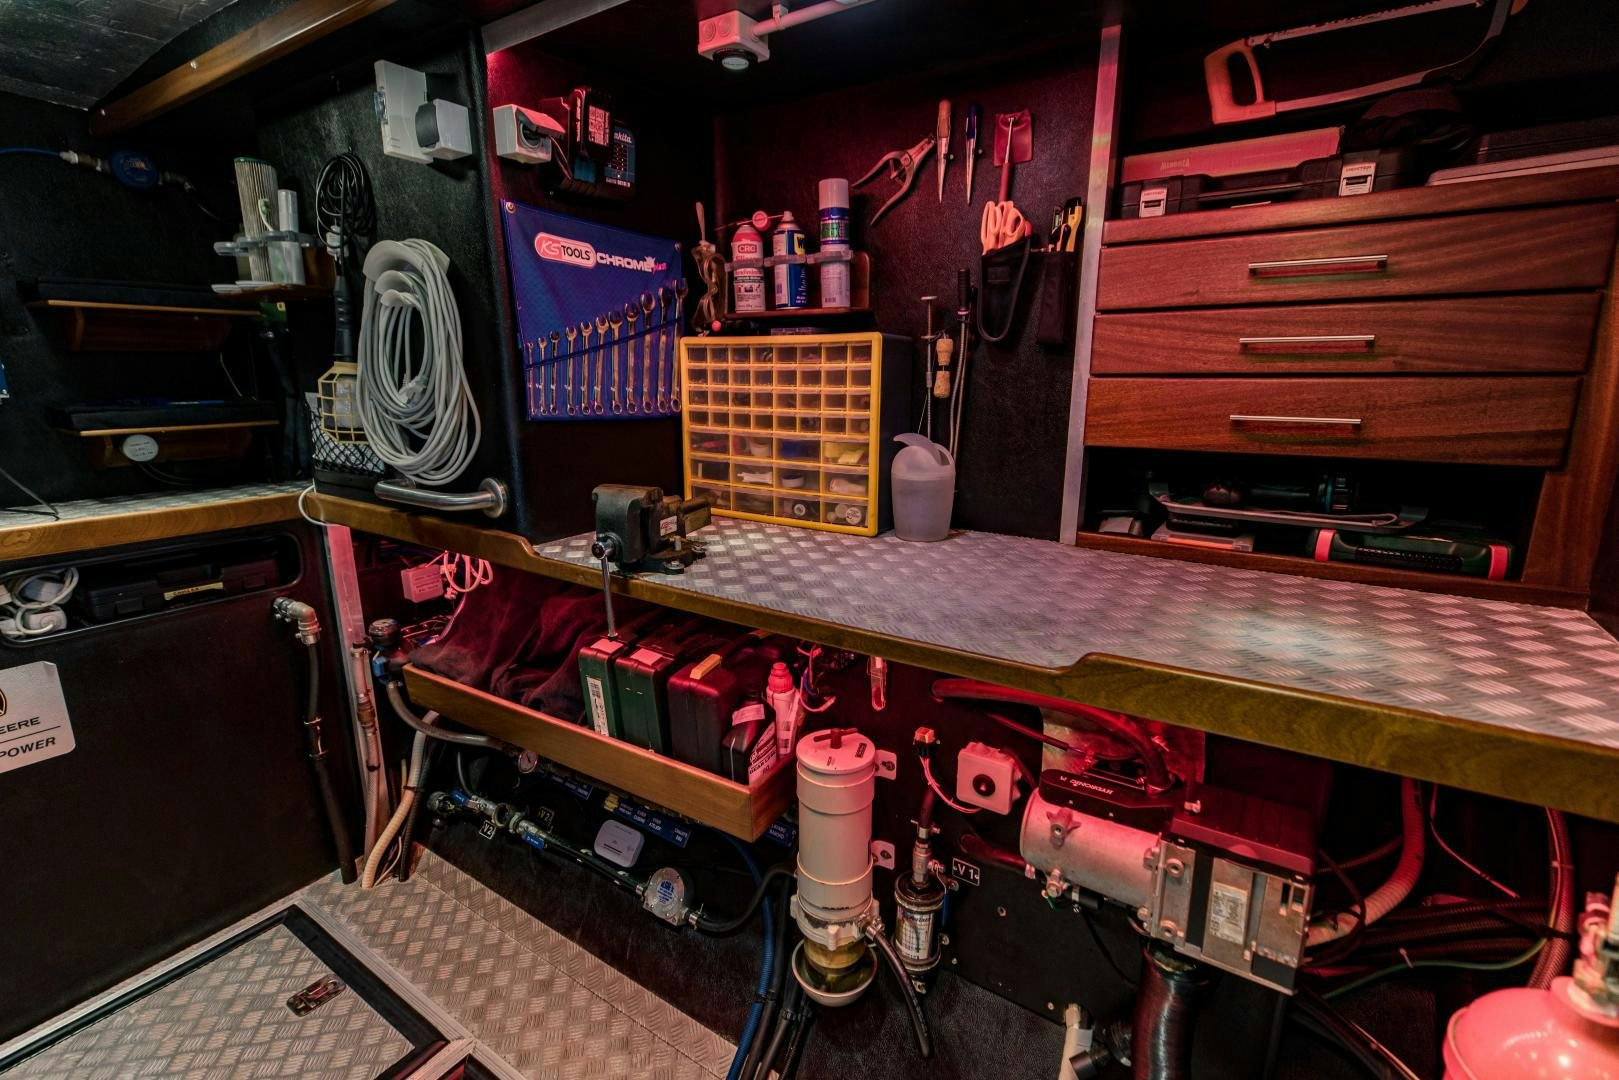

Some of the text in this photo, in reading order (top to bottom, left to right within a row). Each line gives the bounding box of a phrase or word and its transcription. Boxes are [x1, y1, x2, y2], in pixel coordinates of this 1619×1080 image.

[541, 240, 591, 260] KS TOOLS
[738, 245, 757, 253] CRC
[0, 717, 40, 734] EERE
[483, 822, 494, 836] V2
